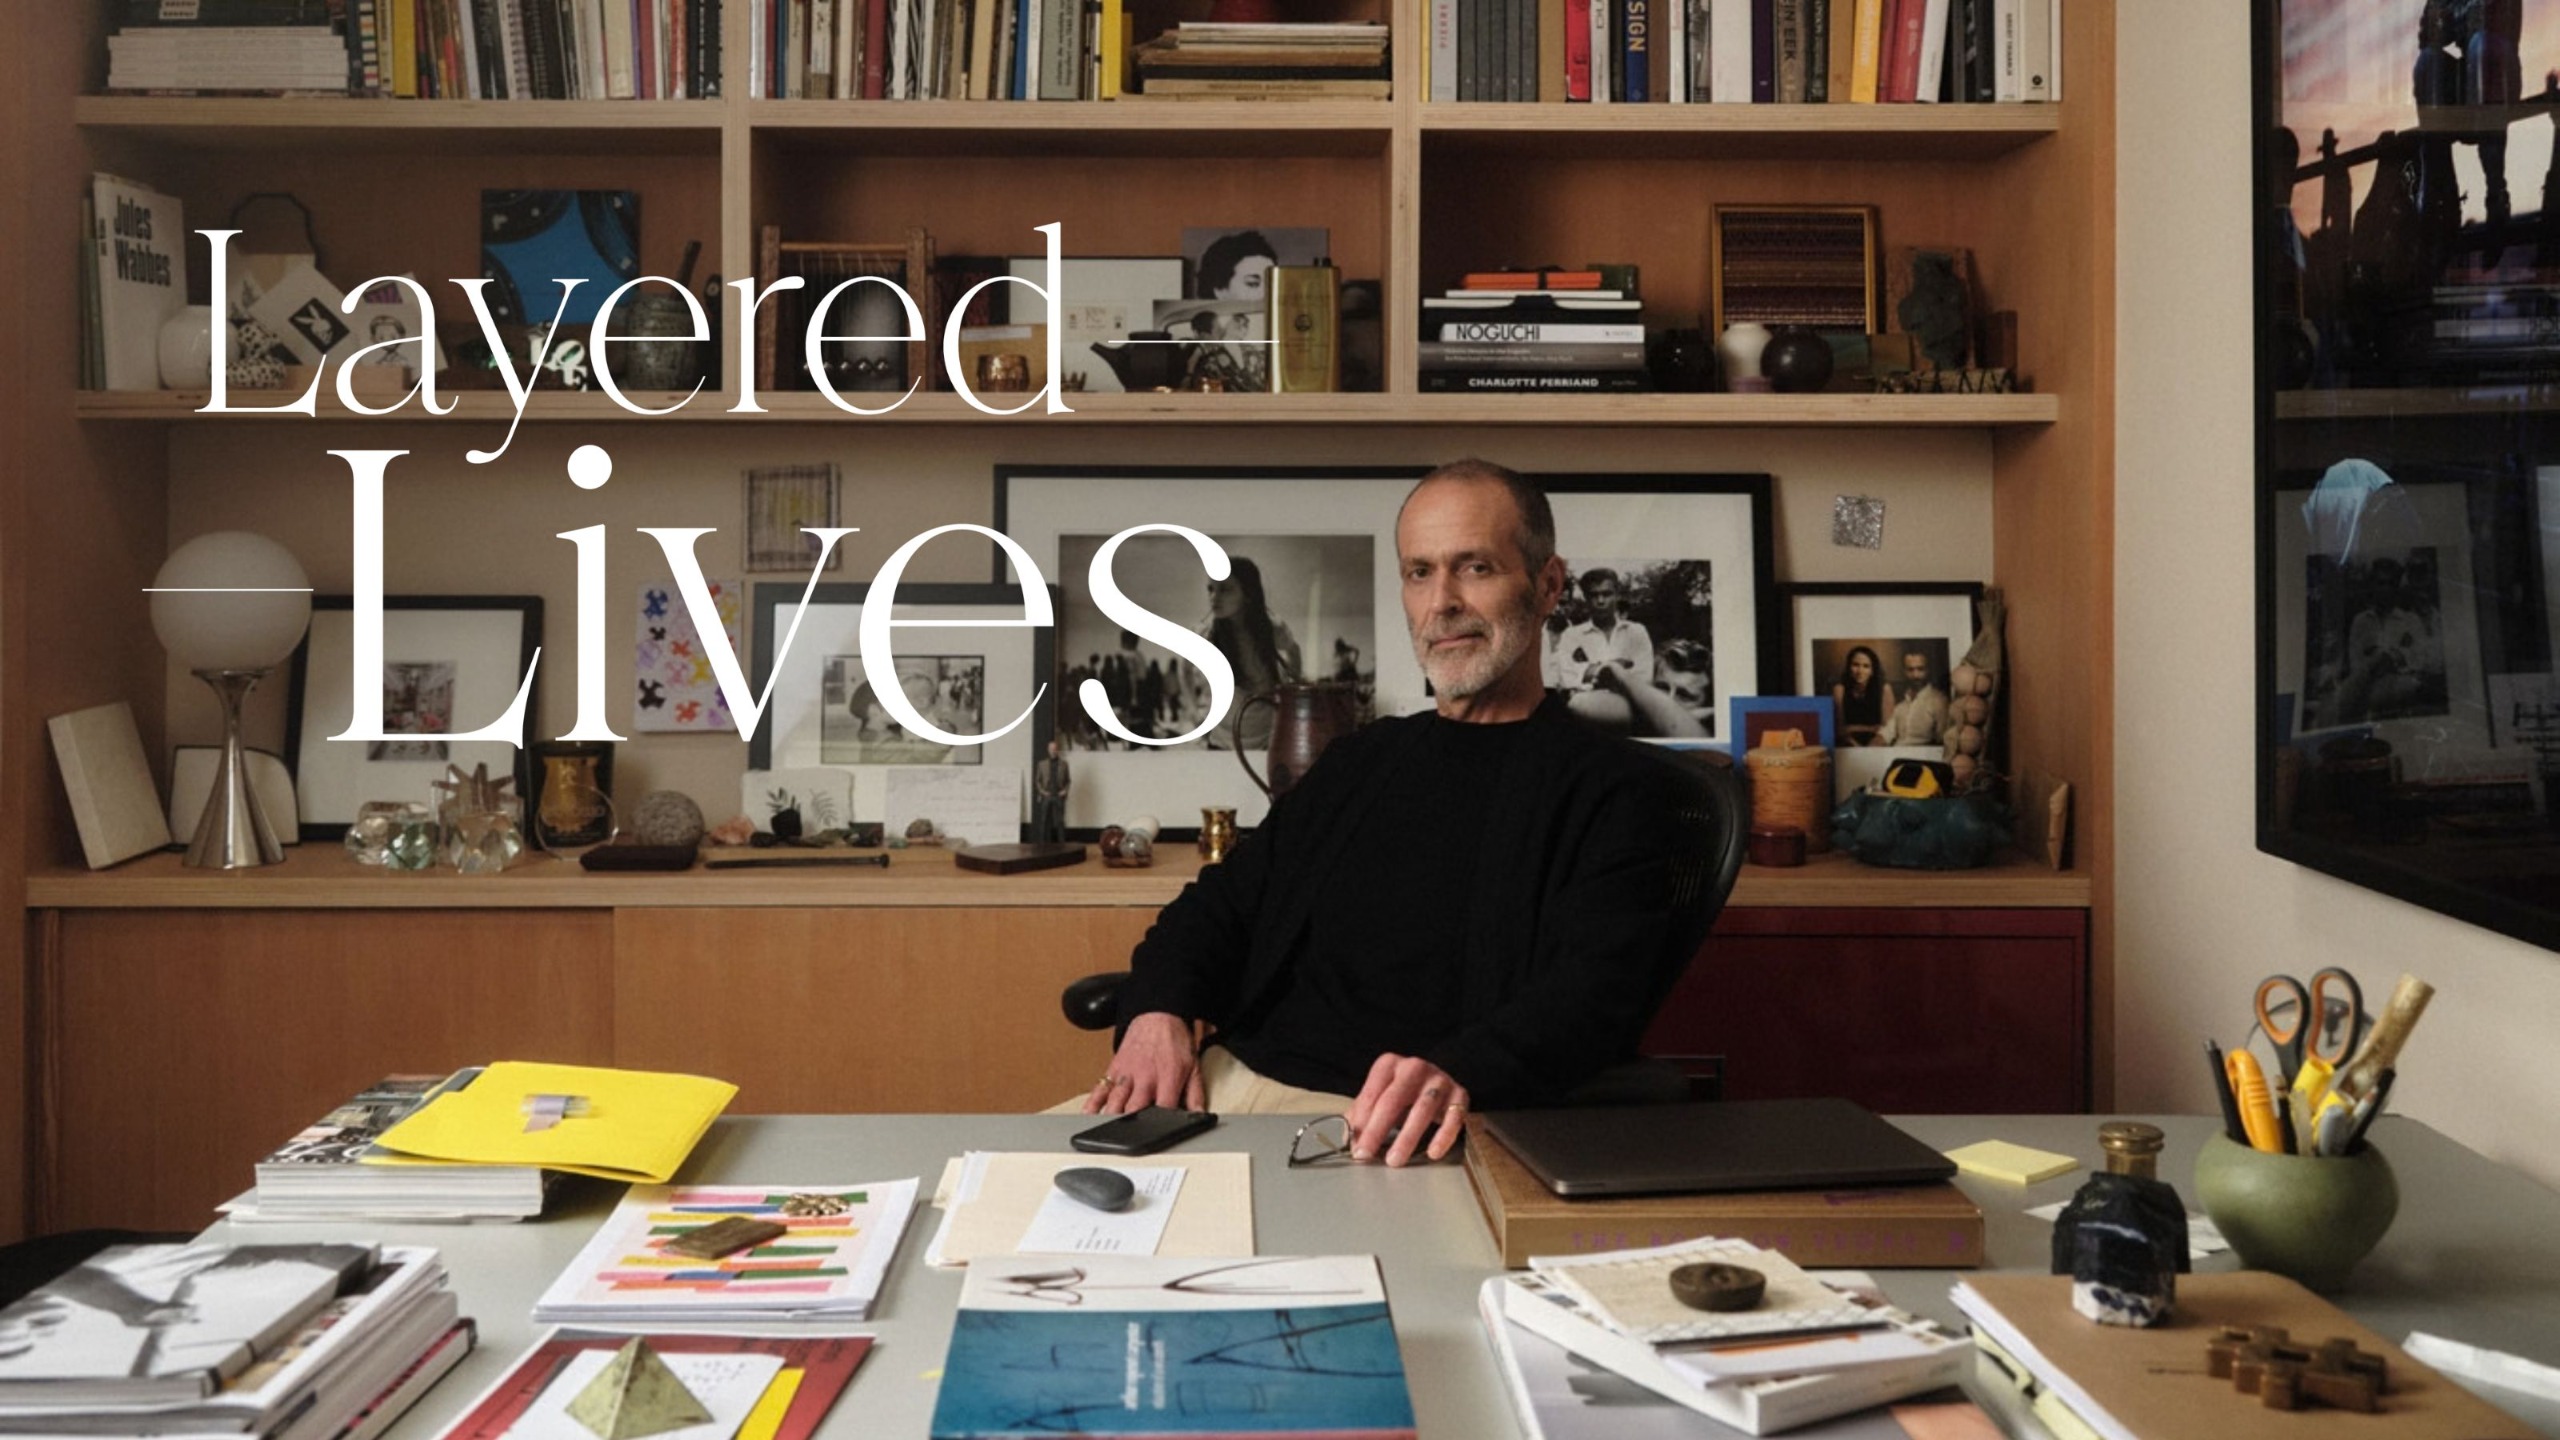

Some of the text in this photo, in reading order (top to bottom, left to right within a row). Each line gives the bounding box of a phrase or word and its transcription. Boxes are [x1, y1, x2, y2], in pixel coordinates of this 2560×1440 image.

[114, 195, 152, 241] Jules
[114, 237, 171, 287] Wabbes
[1456, 324, 1541, 342] NOGUCHI
[1468, 377, 1537, 388] CHARLOTTE
[1539, 377, 1600, 388] PERRIAND
